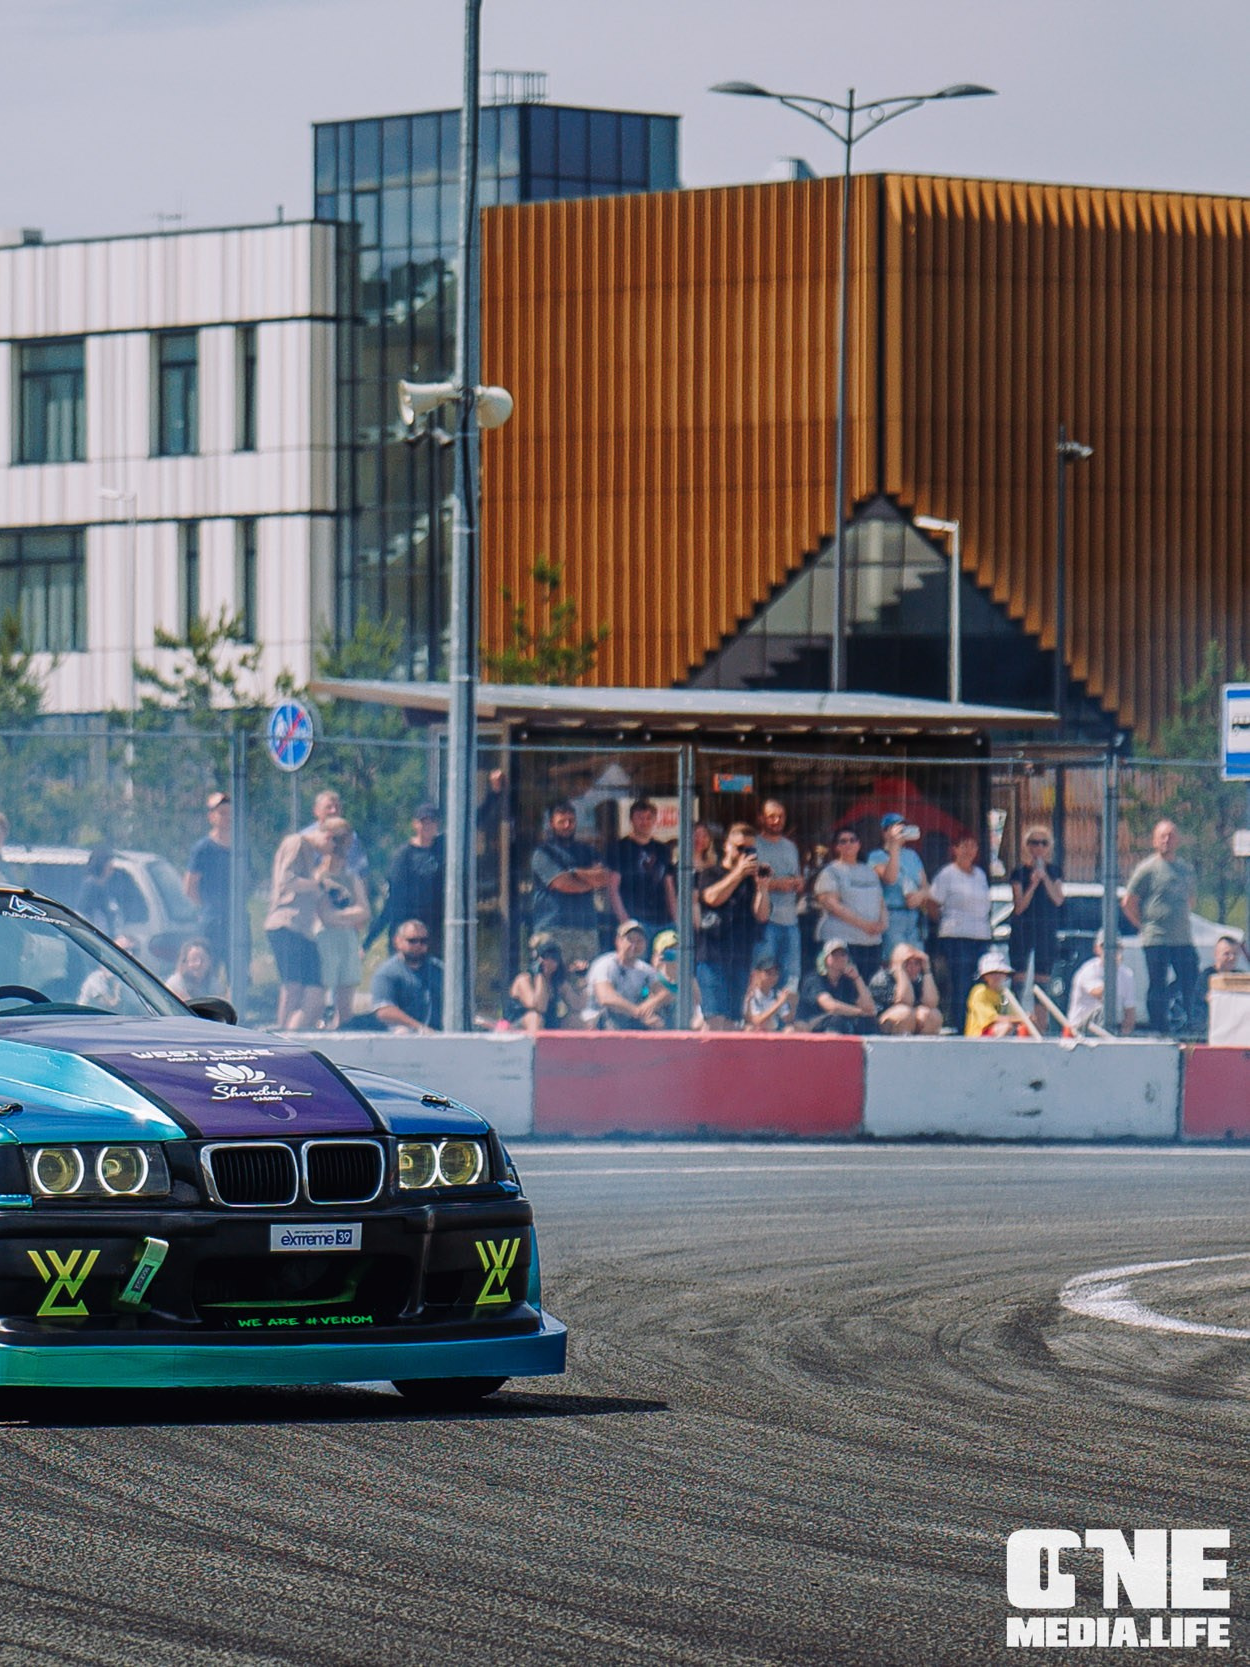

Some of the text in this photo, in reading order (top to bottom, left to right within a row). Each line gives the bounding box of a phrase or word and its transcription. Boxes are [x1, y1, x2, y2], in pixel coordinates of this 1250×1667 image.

[130, 1049, 274, 1059] WEST LAKE
[338, 1231, 350, 1243] 39
[238, 1318, 263, 1327] WE
[268, 1317, 299, 1326] ARE
